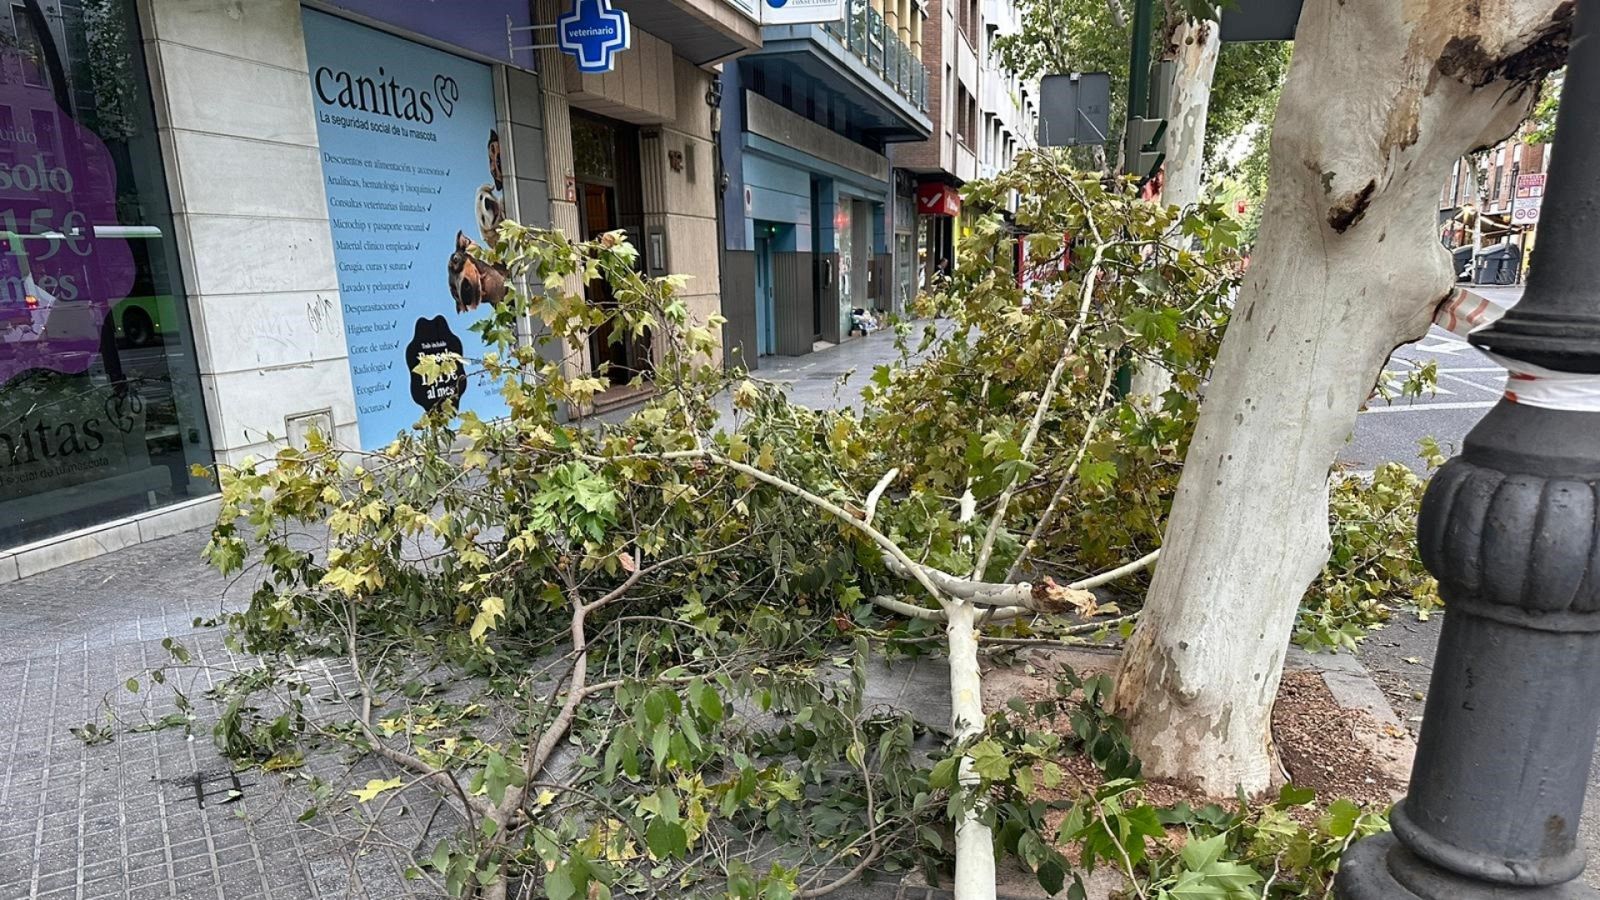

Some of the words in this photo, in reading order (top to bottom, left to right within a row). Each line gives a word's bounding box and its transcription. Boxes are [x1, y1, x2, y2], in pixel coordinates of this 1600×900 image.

[568, 26, 614, 37] veterinario
[315, 66, 434, 125] canitas
[319, 111, 331, 123] La
[331, 115, 369, 130] seguridad
[370, 120, 391, 134] social
[391, 124, 400, 135] de
[401, 126, 408, 137] tu
[409, 129, 437, 142] mascota
[324, 152, 363, 167] Descuentos
[364, 159, 373, 168] en
[374, 160, 411, 173] alimentación
[411, 166, 417, 175] y
[0, 152, 73, 194] solo
[361, 178, 399, 192] hematología
[400, 184, 404, 193] y
[330, 197, 362, 209] Consultas
[363, 200, 397, 211] veterinarias
[333, 218, 366, 231] Microchip
[367, 222, 372, 230] y
[373, 222, 401, 233] pasaporte
[336, 240, 362, 251] Material
[363, 240, 384, 251] clínico
[385, 242, 414, 253] empleado
[366, 263, 382, 271] curas
[383, 264, 388, 272] y
[389, 262, 407, 270] sutura
[341, 282, 365, 293] Lavado
[366, 284, 371, 293] y
[372, 281, 404, 293] peluquería
[344, 303, 400, 316] Desparasitaciones
[347, 323, 373, 336] Higiene
[374, 322, 391, 332] bucal
[350, 345, 369, 356] Corte
[370, 343, 378, 352] de
[379, 341, 394, 351] uñas
[353, 363, 386, 376] Radiología
[426, 385, 436, 399] al
[437, 386, 455, 397] mes
[359, 402, 386, 415] Vacunas
